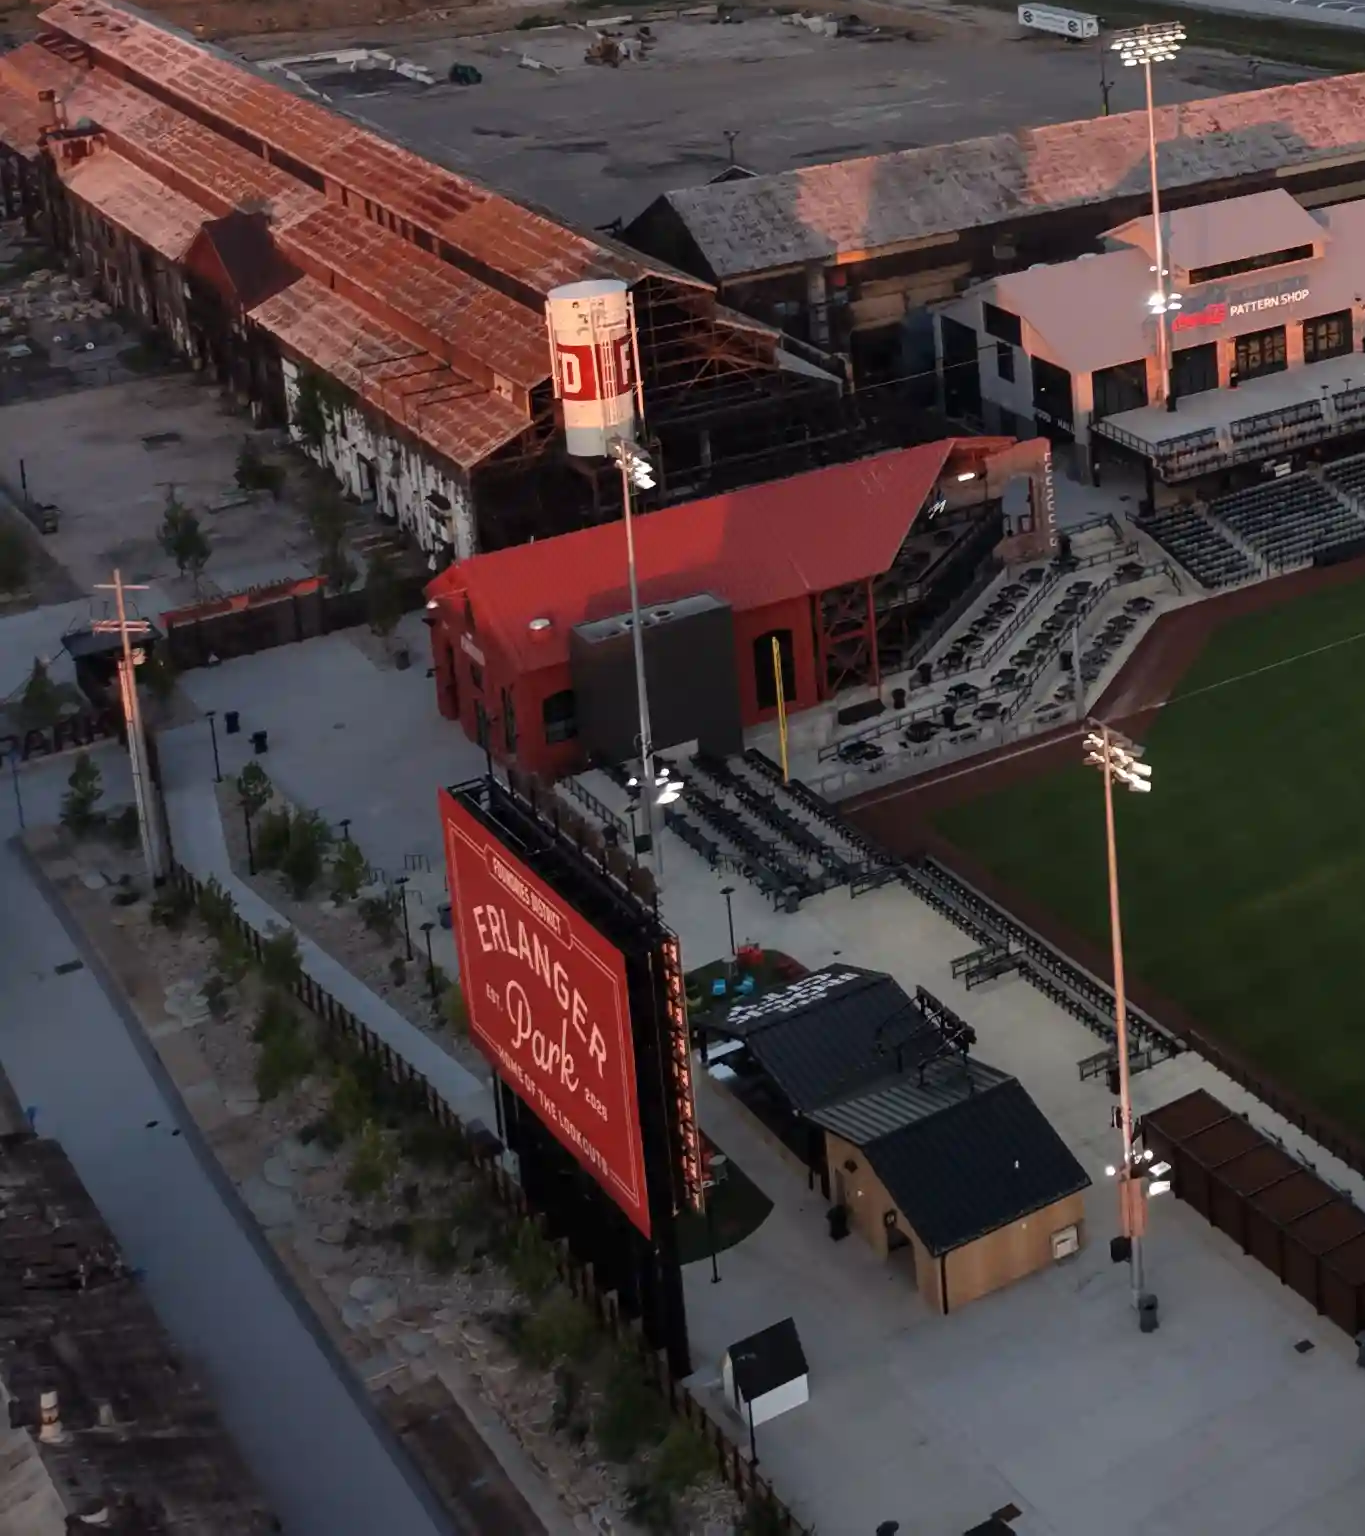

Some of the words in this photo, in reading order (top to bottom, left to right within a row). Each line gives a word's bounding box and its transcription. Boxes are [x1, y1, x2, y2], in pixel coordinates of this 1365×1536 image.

[1230, 295, 1279, 317] PATTERN
[1280, 288, 1310, 305] SHOP
[472, 903, 608, 1080] ERLANGER
[506, 979, 580, 1093] Park
[499, 1046, 525, 1084] HOME
[524, 1073, 536, 1097] OF
[537, 1088, 558, 1121] THE
[558, 1109, 609, 1176] LOOKOUTS
